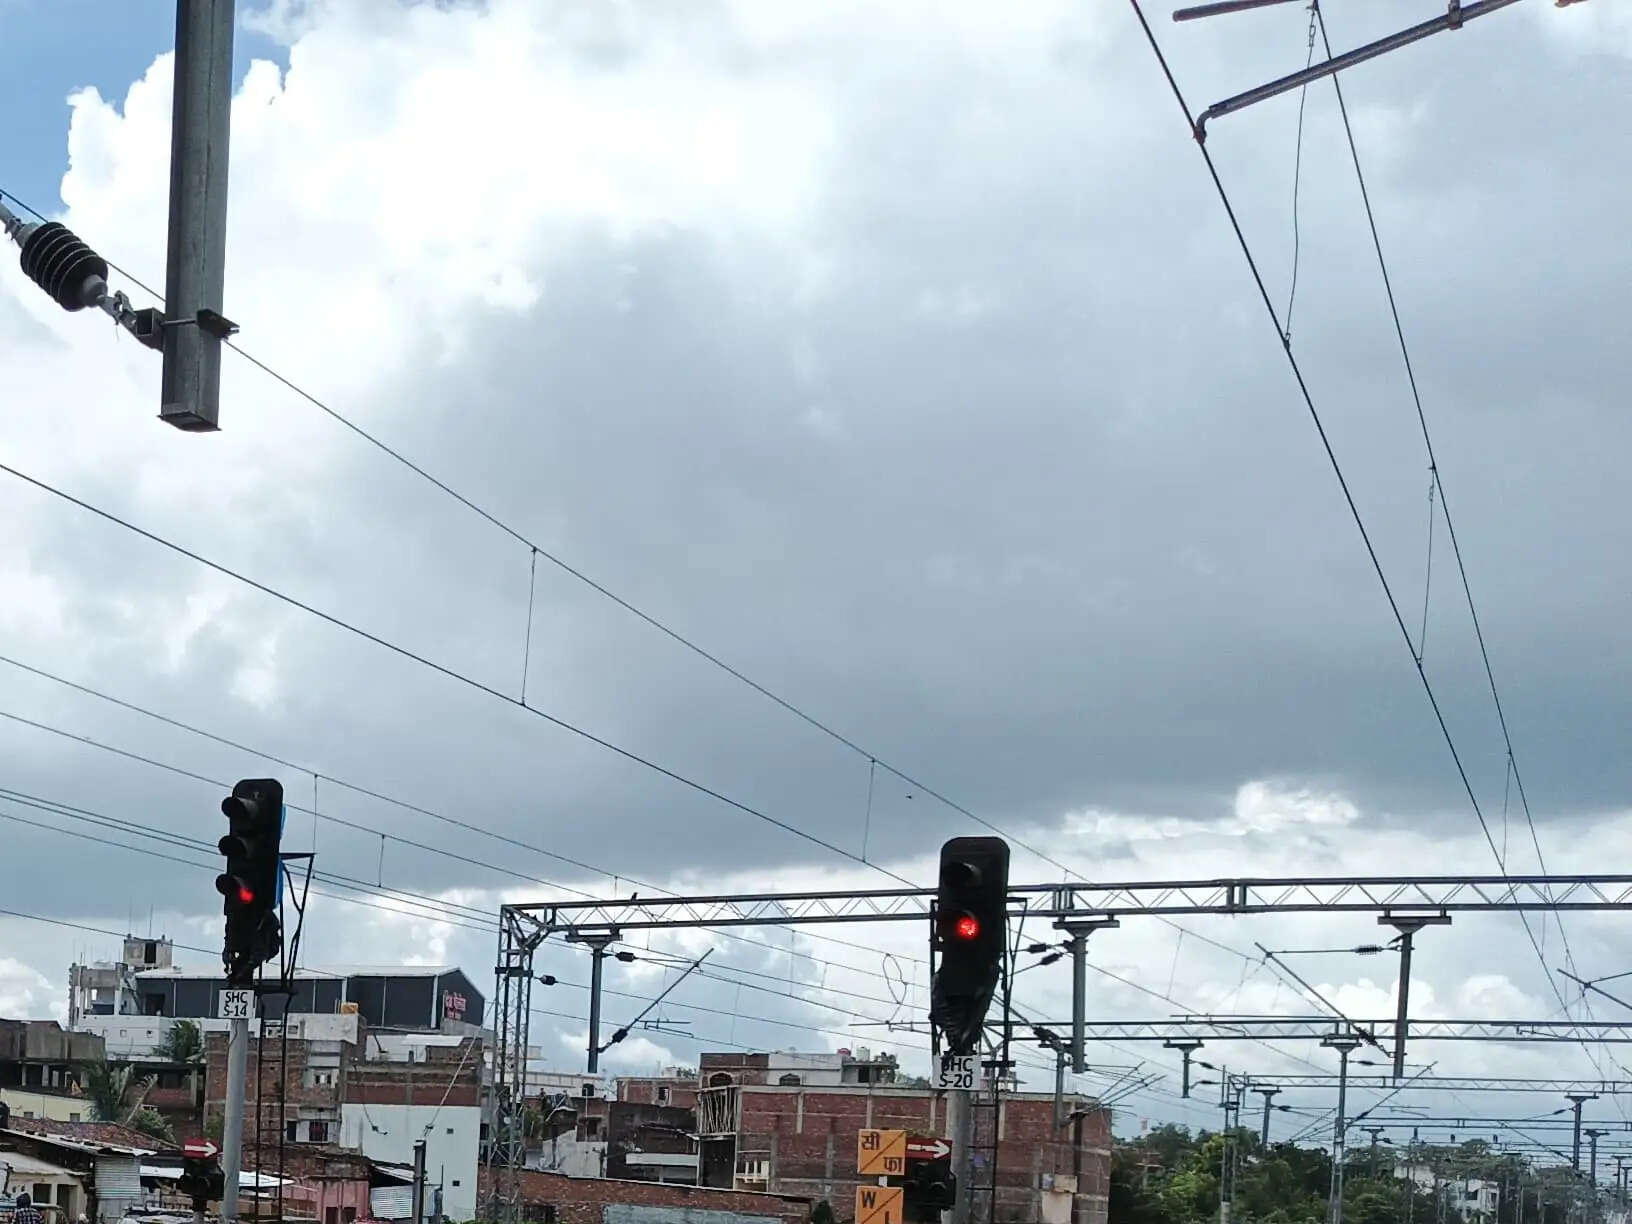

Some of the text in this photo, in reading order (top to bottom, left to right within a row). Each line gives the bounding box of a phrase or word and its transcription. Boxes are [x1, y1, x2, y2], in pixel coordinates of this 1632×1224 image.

[224, 991, 248, 1003] SHC
[224, 1004, 247, 1016] S-14
[939, 1073, 973, 1088] S-20
[862, 1132, 879, 1150] सी
[862, 1191, 876, 1209] W
